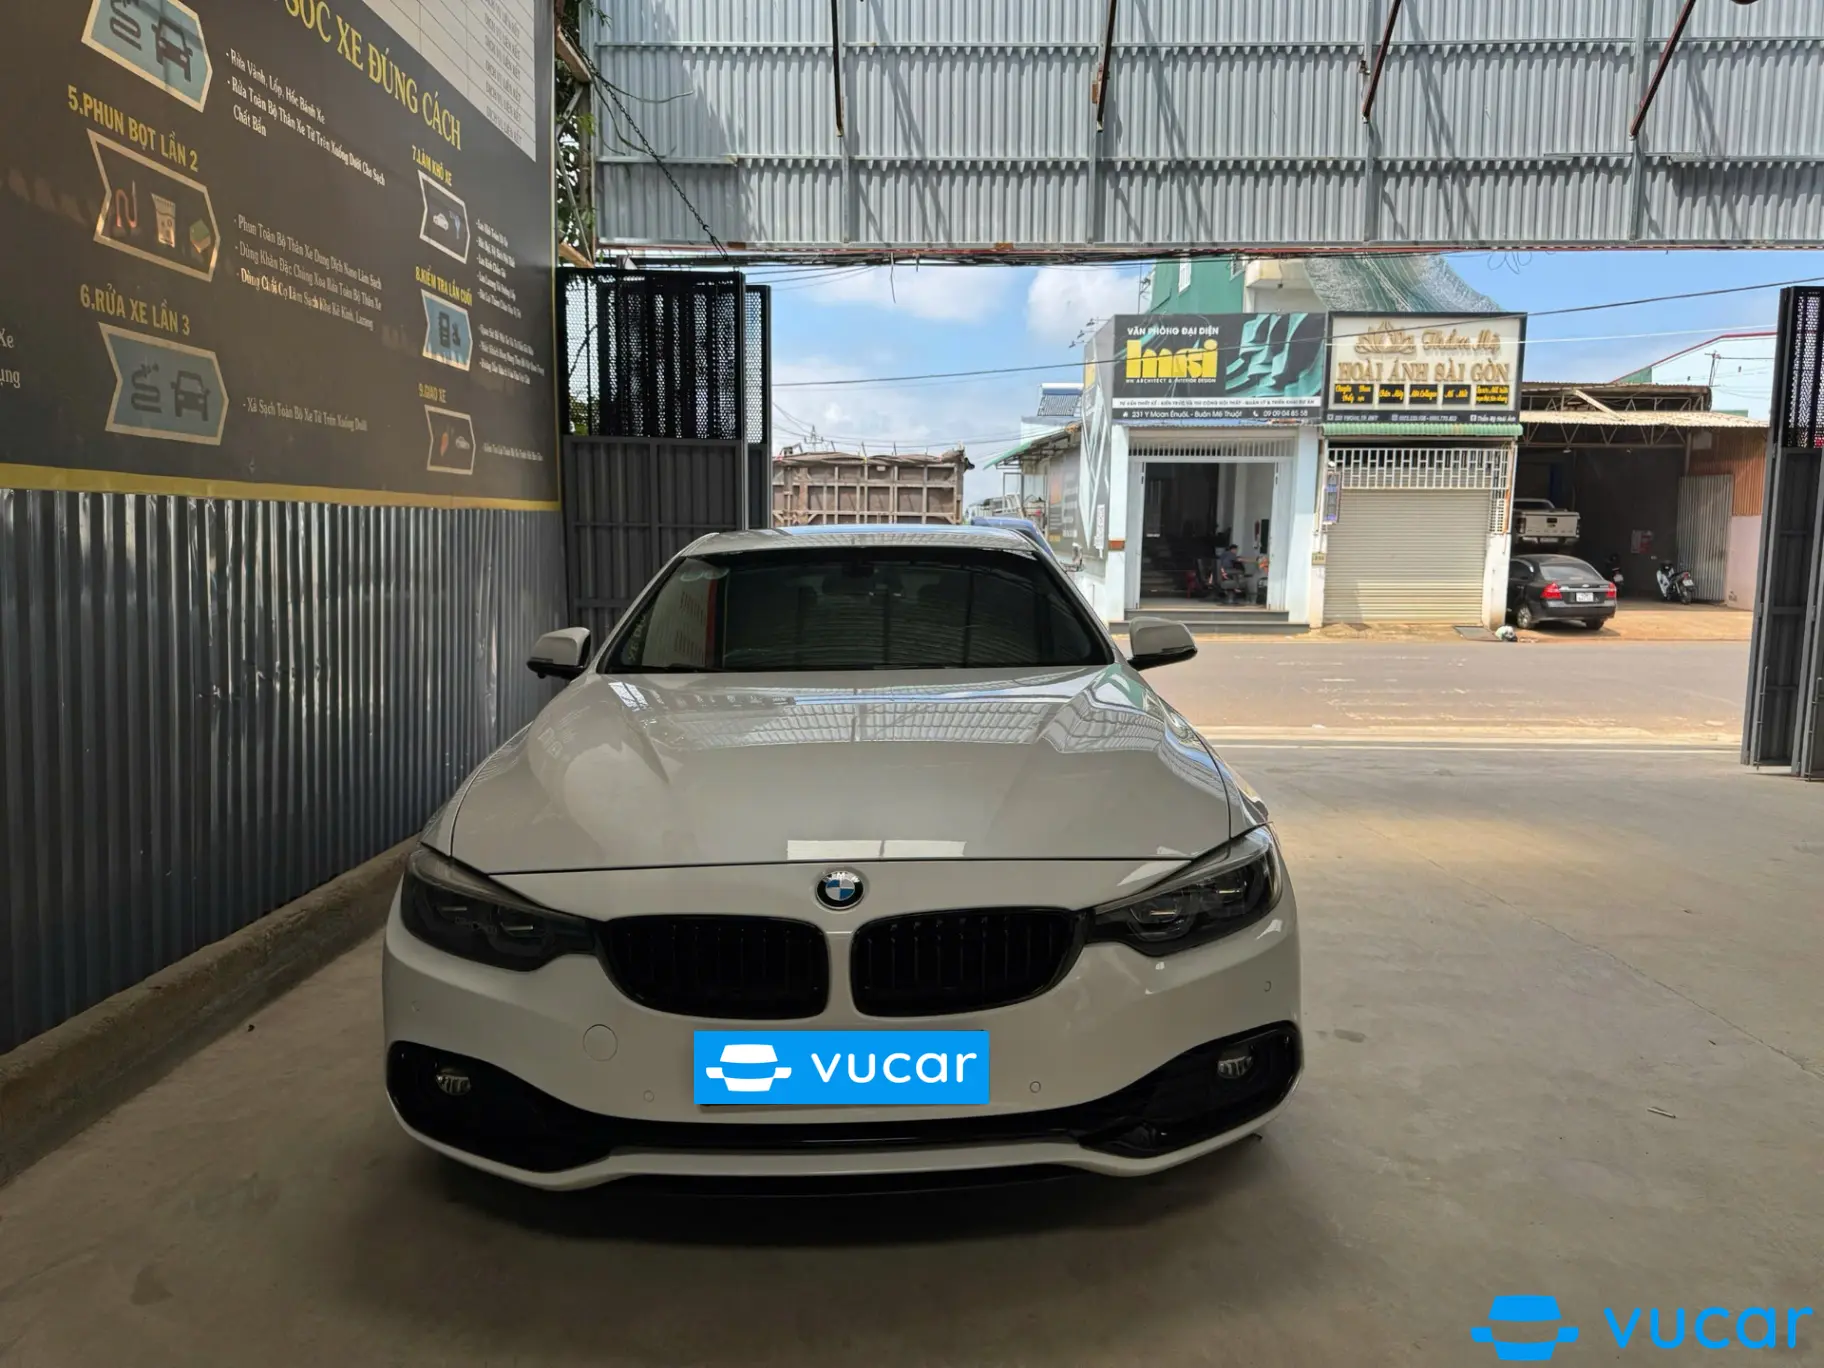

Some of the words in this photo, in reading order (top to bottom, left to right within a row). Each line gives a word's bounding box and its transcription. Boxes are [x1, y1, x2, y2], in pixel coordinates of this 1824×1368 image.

[336, 15, 364, 71] XE
[368, 42, 418, 114] ĐÚNG
[422, 91, 461, 150] CÁCH
[68, 84, 124, 136] 5.PHUN
[128, 116, 156, 151] BỌT
[160, 130, 186, 167] LẦN
[190, 150, 198, 172] 2
[233, 104, 251, 128] Chất
[267, 99, 278, 120] Bộ
[296, 118, 305, 136] Xe
[316, 108, 325, 125] Xe
[80, 283, 126, 318] 6.RỬA
[129, 298, 148, 324] XE
[152, 299, 178, 333] LẦN
[182, 314, 190, 336] 3
[1127, 325, 1146, 336] VĂN
[1148, 325, 1180, 336] PHÒNG
[1181, 326, 1197, 337] ĐẠI
[1198, 325, 1219, 337] DIỆN
[1337, 357, 1383, 382] HOÀI
[1387, 357, 1429, 382] ÁNH
[1434, 357, 1466, 382] SÀI
[1470, 357, 1510, 382] GÒN
[1150, 410, 1169, 418] Moan
